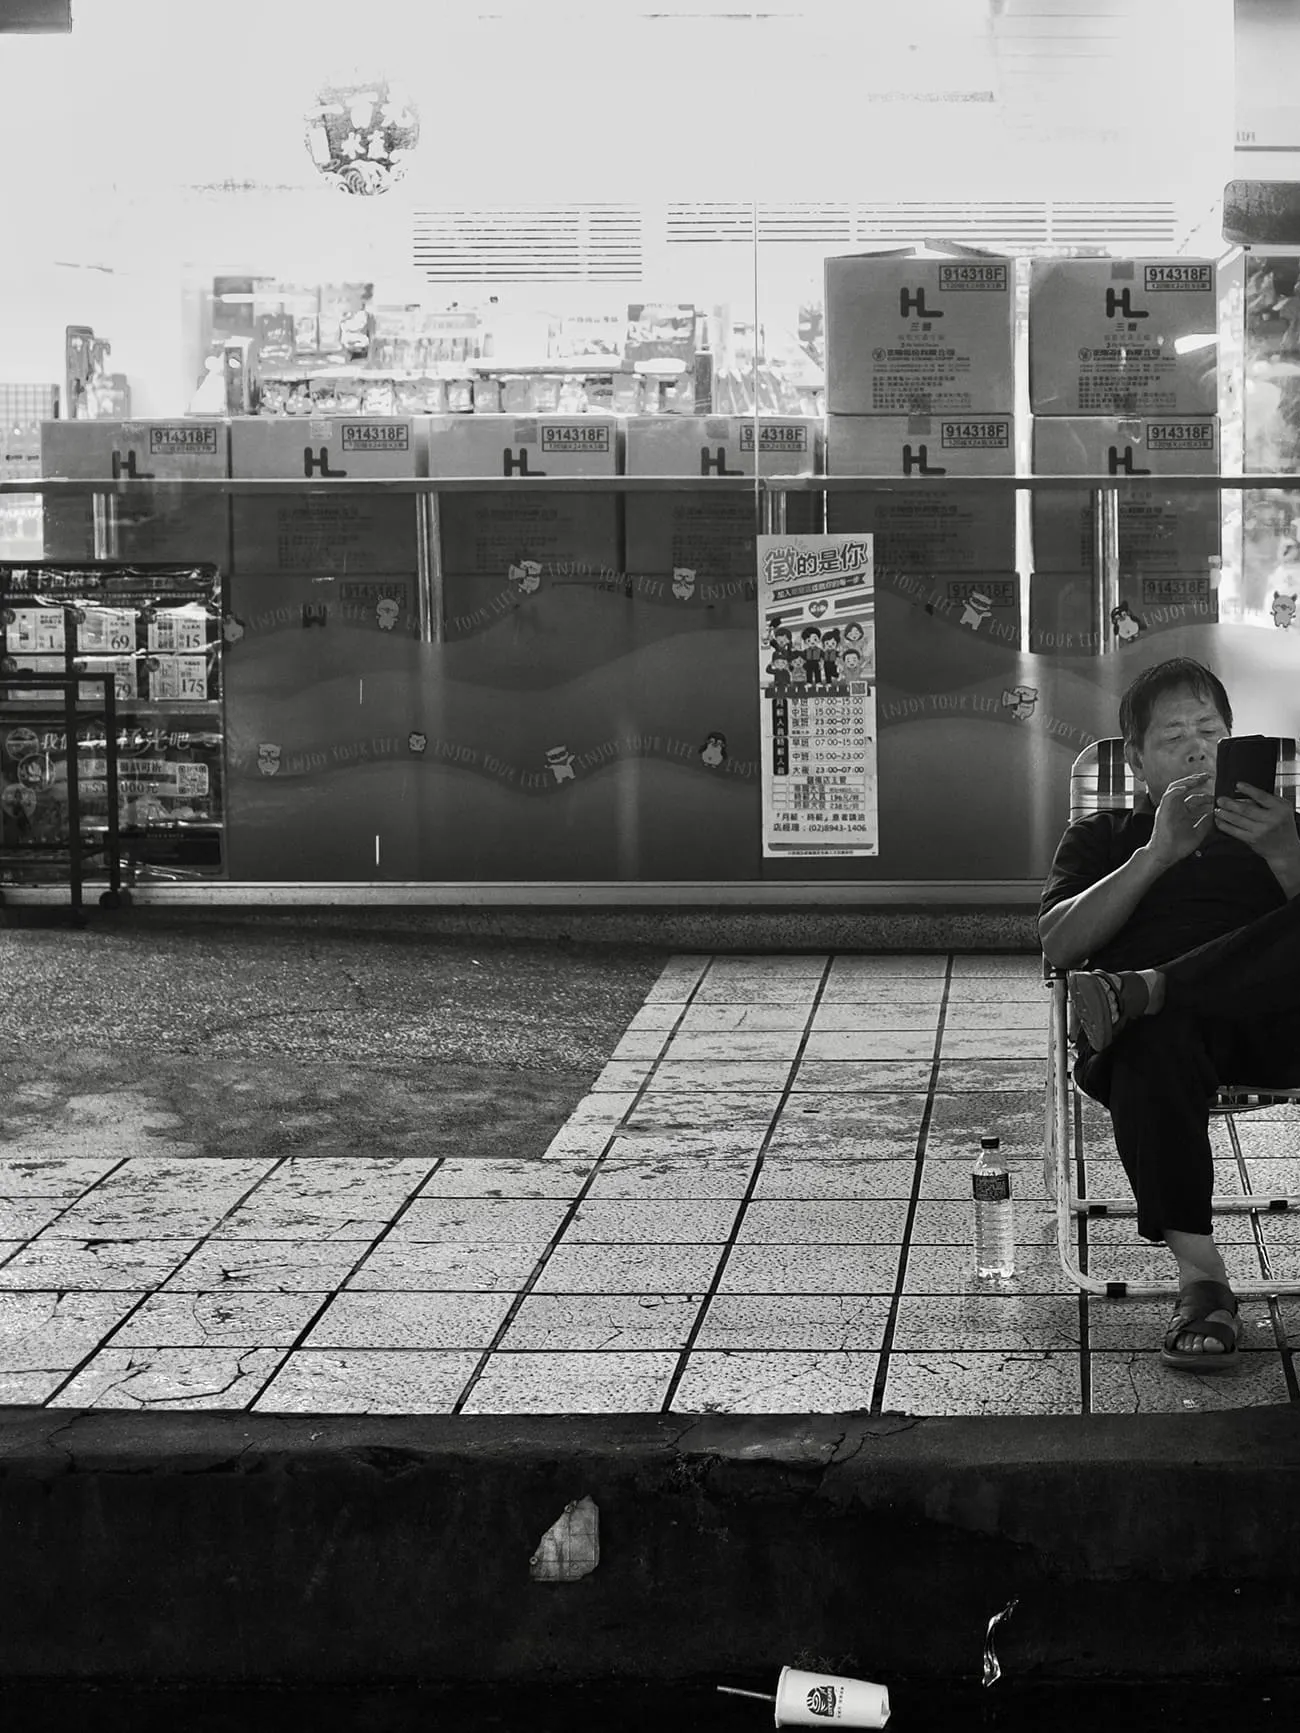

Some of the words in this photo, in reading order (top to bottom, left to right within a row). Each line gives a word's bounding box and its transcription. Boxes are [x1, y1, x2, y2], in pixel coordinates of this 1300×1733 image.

[944, 267, 1003, 281] 914318F
[1149, 267, 1208, 281] 914318F
[899, 286, 944, 318] HL
[1106, 287, 1150, 318] HL
[155, 430, 212, 443] 914318F
[347, 427, 405, 440] 914318F
[547, 428, 605, 441] 914318F
[745, 428, 804, 441] 94318F
[946, 424, 1005, 437] 914318F
[1151, 426, 1210, 439] 914318F
[112, 450, 154, 479] HL
[303, 447, 347, 477] HL
[503, 447, 546, 477] HL
[700, 446, 744, 476] HL
[902, 444, 946, 475] HL
[1108, 445, 1150, 475] HL
[764, 541, 868, 584] 徵的是你
[110, 634, 130, 650] 69
[182, 679, 204, 693] 175
